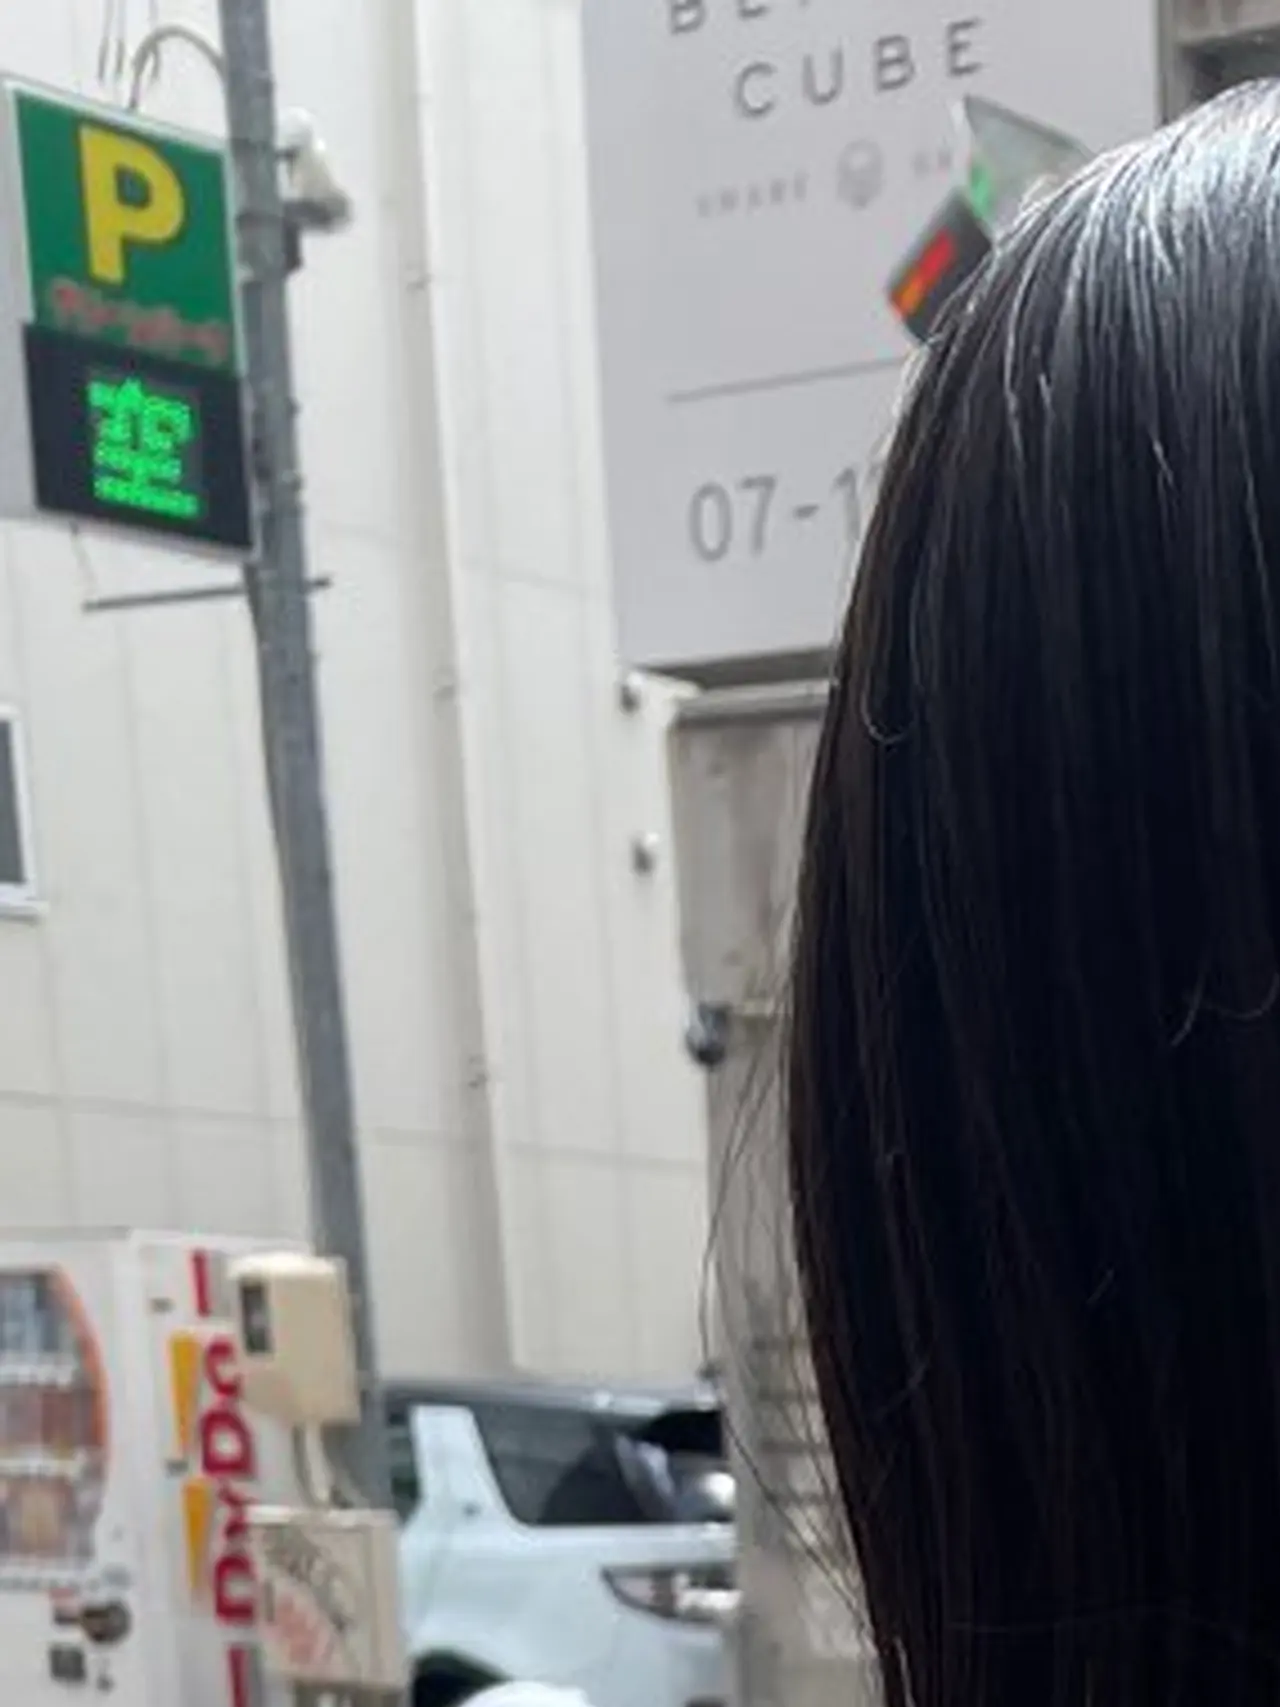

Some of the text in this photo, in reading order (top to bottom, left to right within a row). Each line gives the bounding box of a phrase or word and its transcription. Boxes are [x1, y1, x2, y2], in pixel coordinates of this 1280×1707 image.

[733, 16, 984, 119] CUBE
[79, 121, 187, 285] P
[688, 461, 880, 561] 07-1
